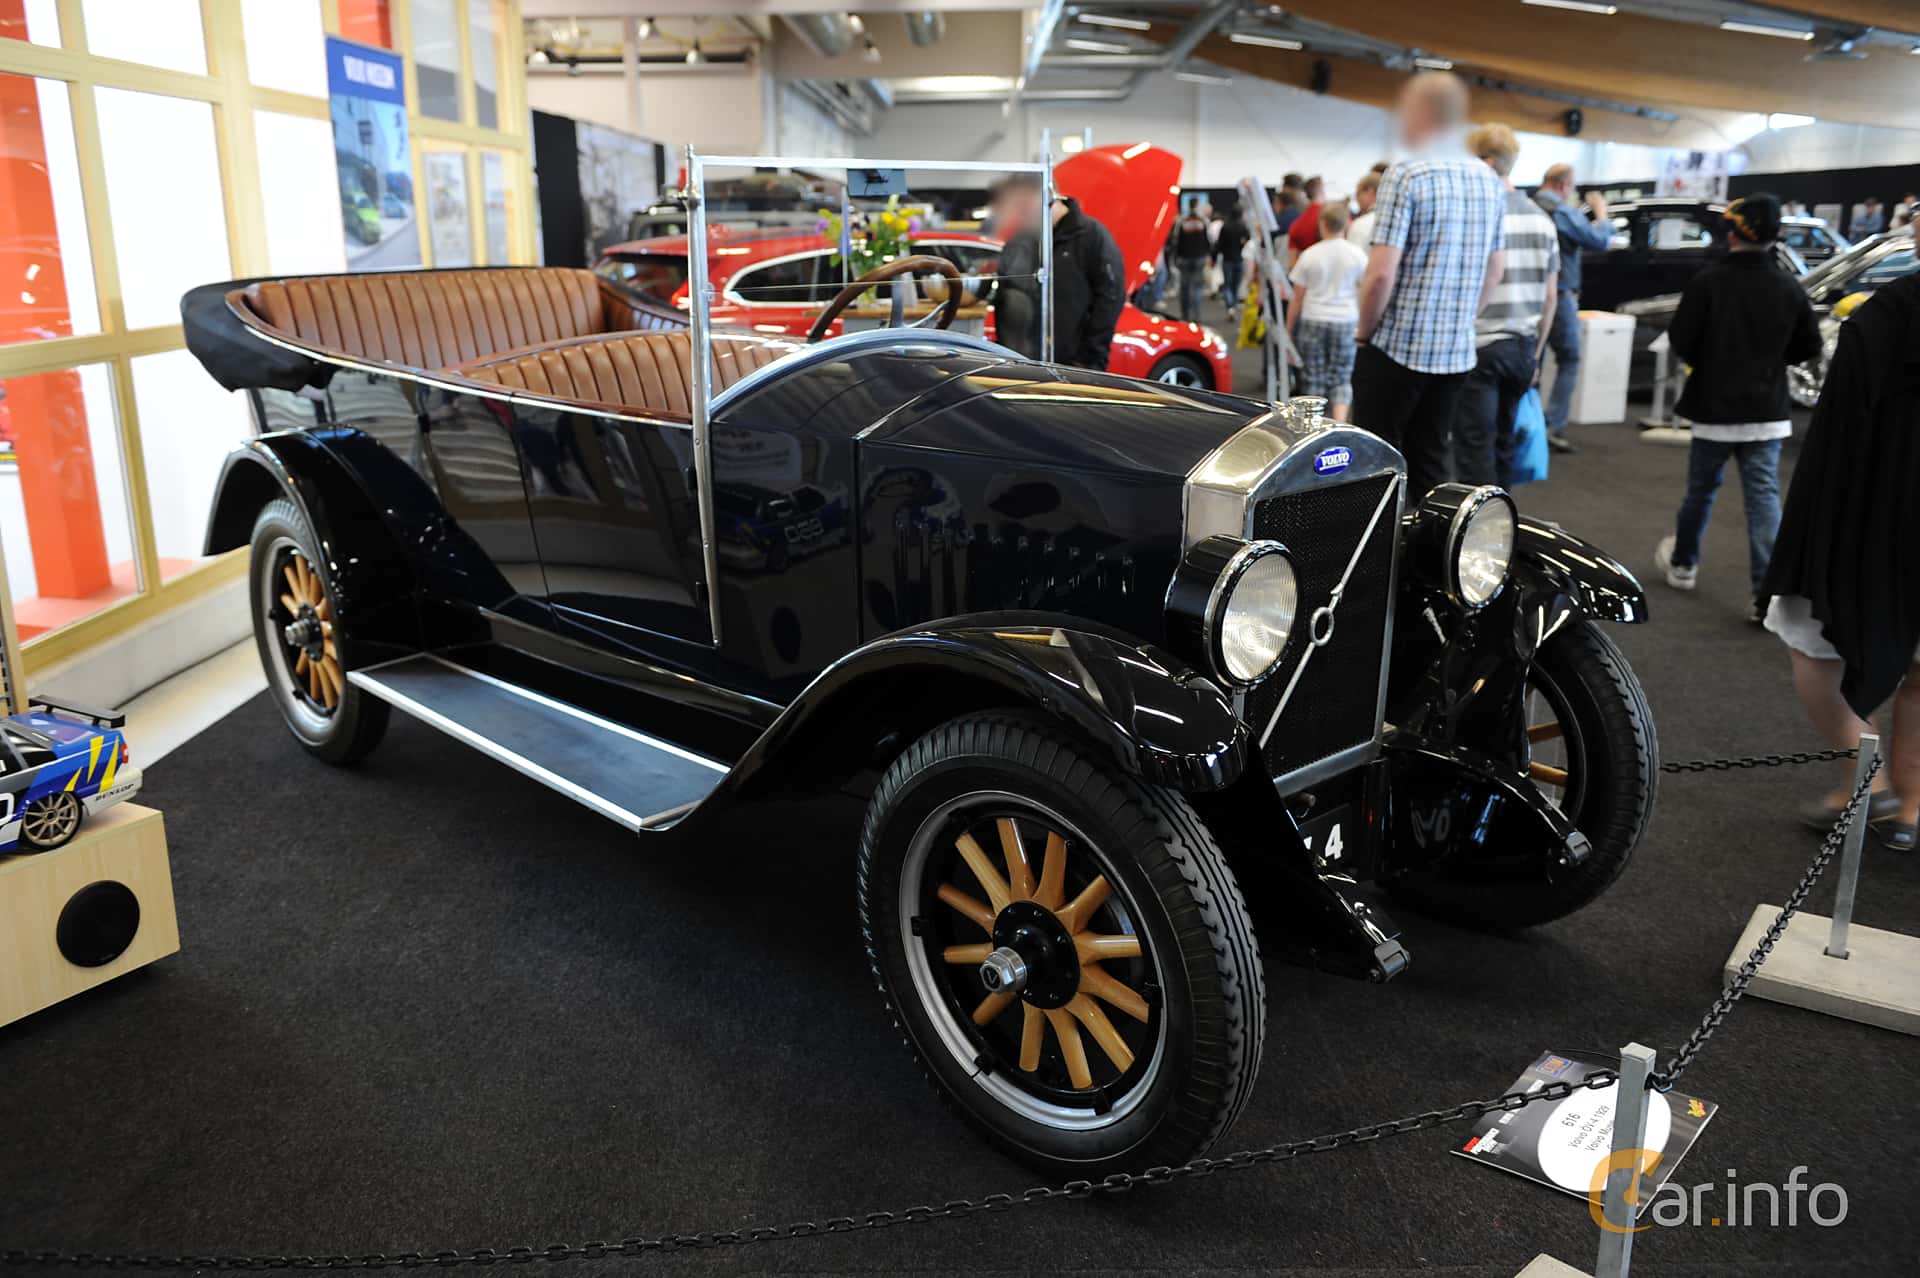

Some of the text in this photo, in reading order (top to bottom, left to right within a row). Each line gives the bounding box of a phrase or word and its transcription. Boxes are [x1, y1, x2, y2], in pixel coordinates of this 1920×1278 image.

[1320, 452, 1350, 468] VOLVO
[1561, 1112, 1581, 1127] 616
[1567, 1131, 1588, 1148] Volvo
[1584, 1135, 1606, 1151] Volvo
